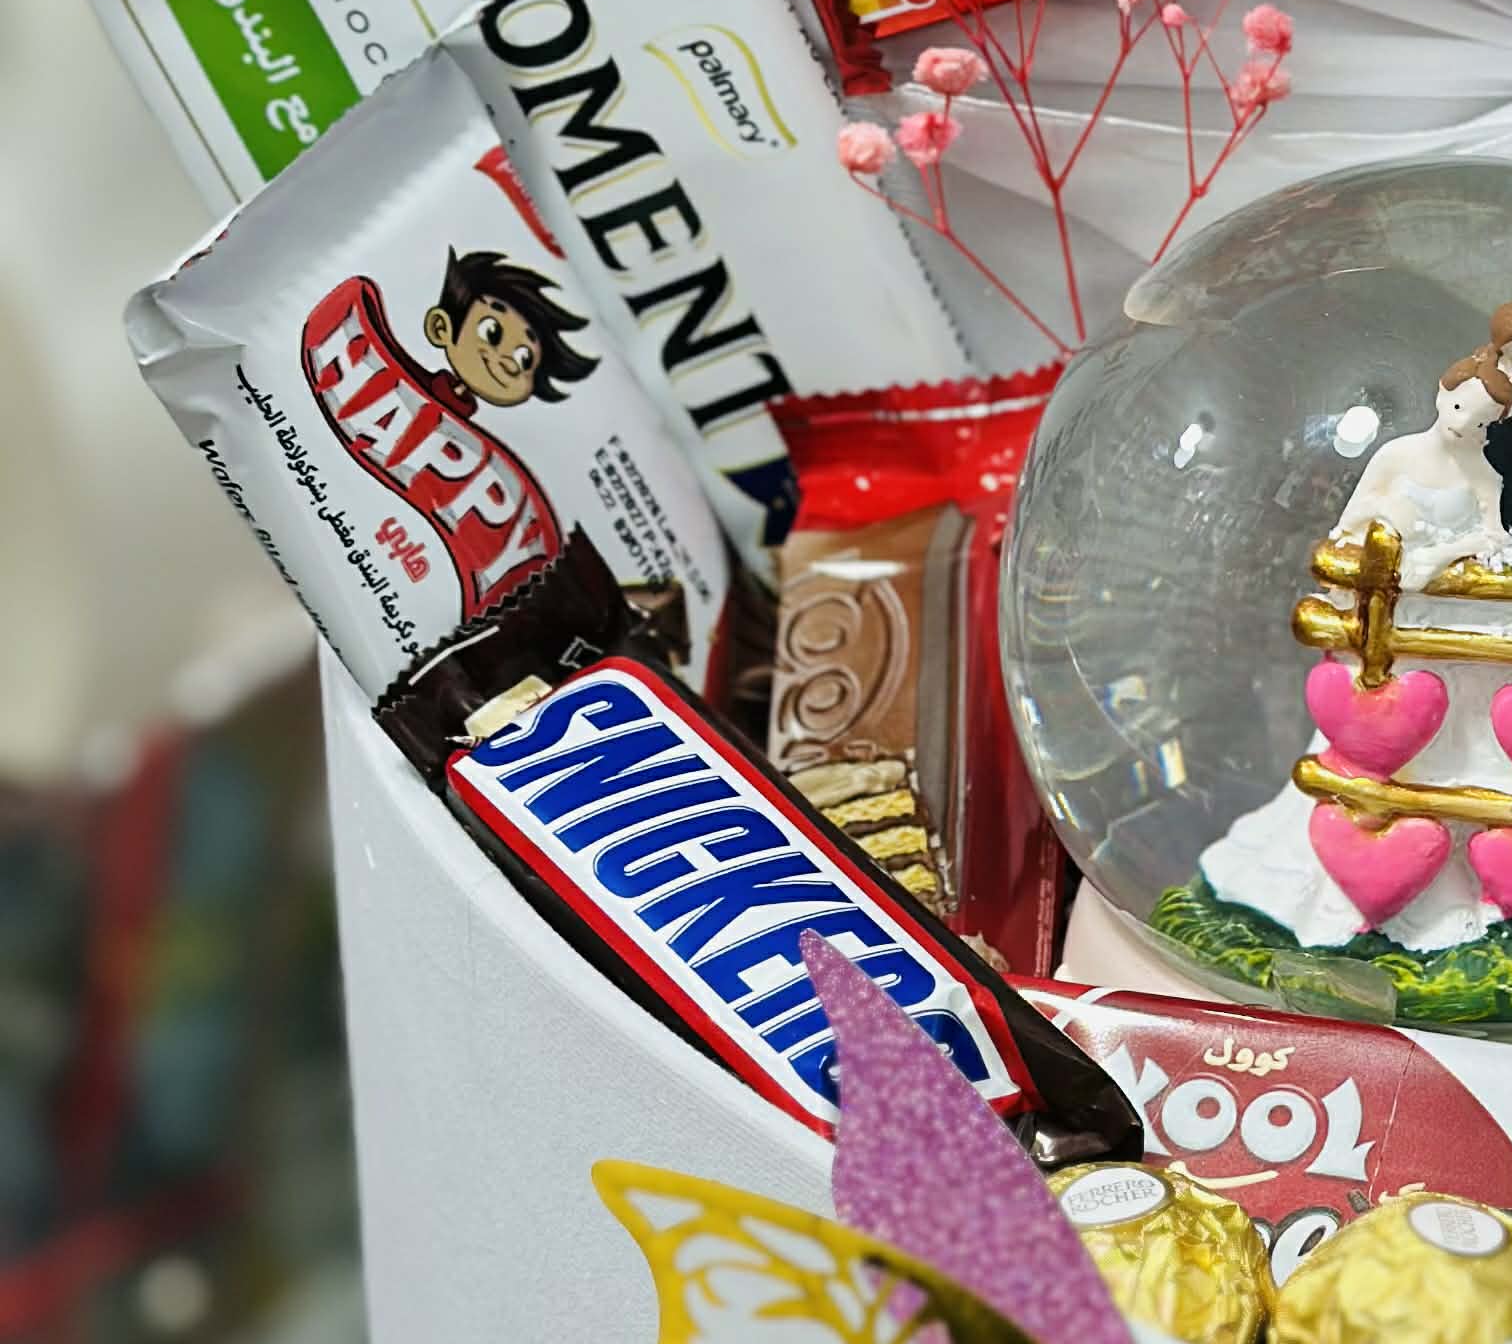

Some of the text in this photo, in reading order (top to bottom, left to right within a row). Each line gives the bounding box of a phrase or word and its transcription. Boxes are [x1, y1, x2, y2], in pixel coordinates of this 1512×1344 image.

[265, 93, 319, 143] مع
[678, 38, 766, 147] palmary
[236, 363, 287, 428] الحليب
[310, 311, 550, 603] HAPPY
[318, 504, 356, 549] مغطى
[375, 516, 431, 584] هابي
[347, 547, 391, 595] البندق
[1204, 1038, 1297, 1077] كوول
